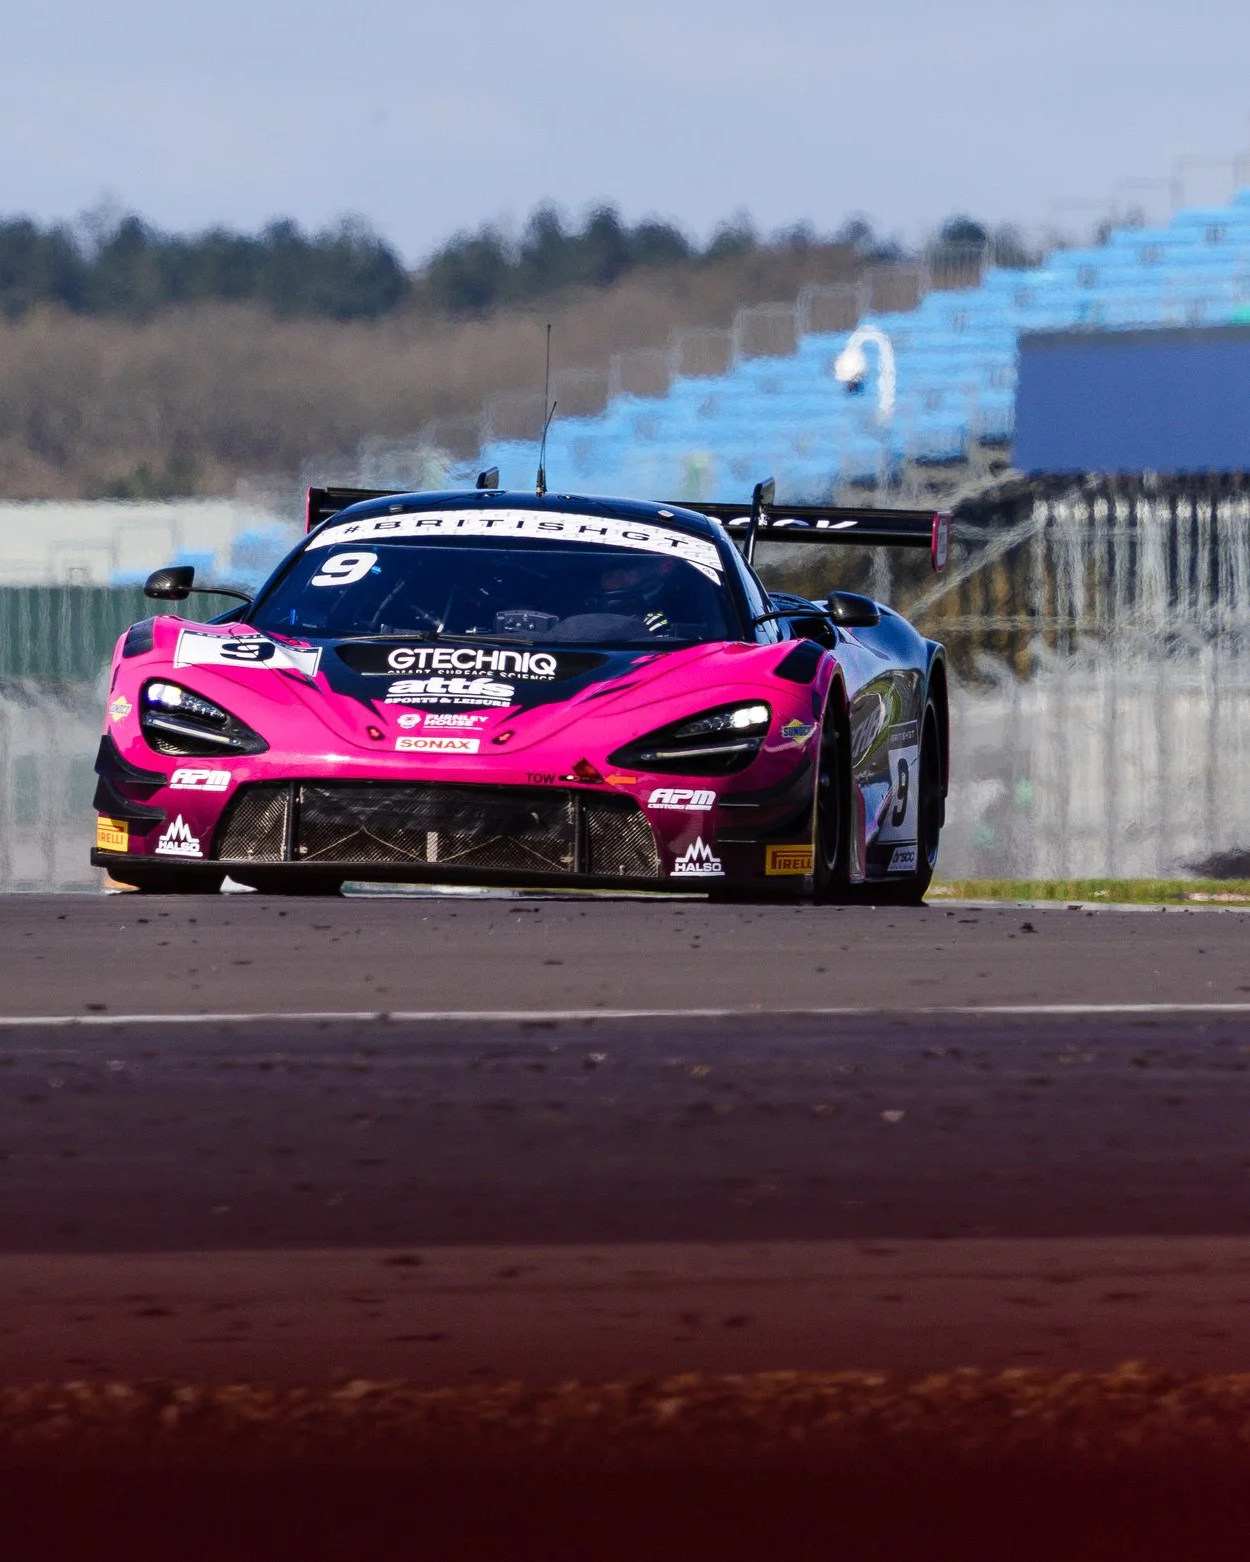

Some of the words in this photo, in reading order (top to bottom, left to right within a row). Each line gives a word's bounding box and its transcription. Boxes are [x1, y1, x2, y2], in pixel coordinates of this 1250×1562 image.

[311, 552, 378, 587] 9
[220, 642, 276, 662] 9
[387, 648, 557, 675] GTECHNIQ
[453, 697, 510, 707] LEISURE
[400, 739, 470, 749] SONAX
[170, 768, 231, 786] APM
[526, 773, 555, 784] TOW
[648, 788, 716, 805] APM
[891, 758, 909, 827] 9
[159, 841, 200, 852] HALSO
[675, 863, 722, 872] HALSO
[771, 850, 813, 869] PIRELL
